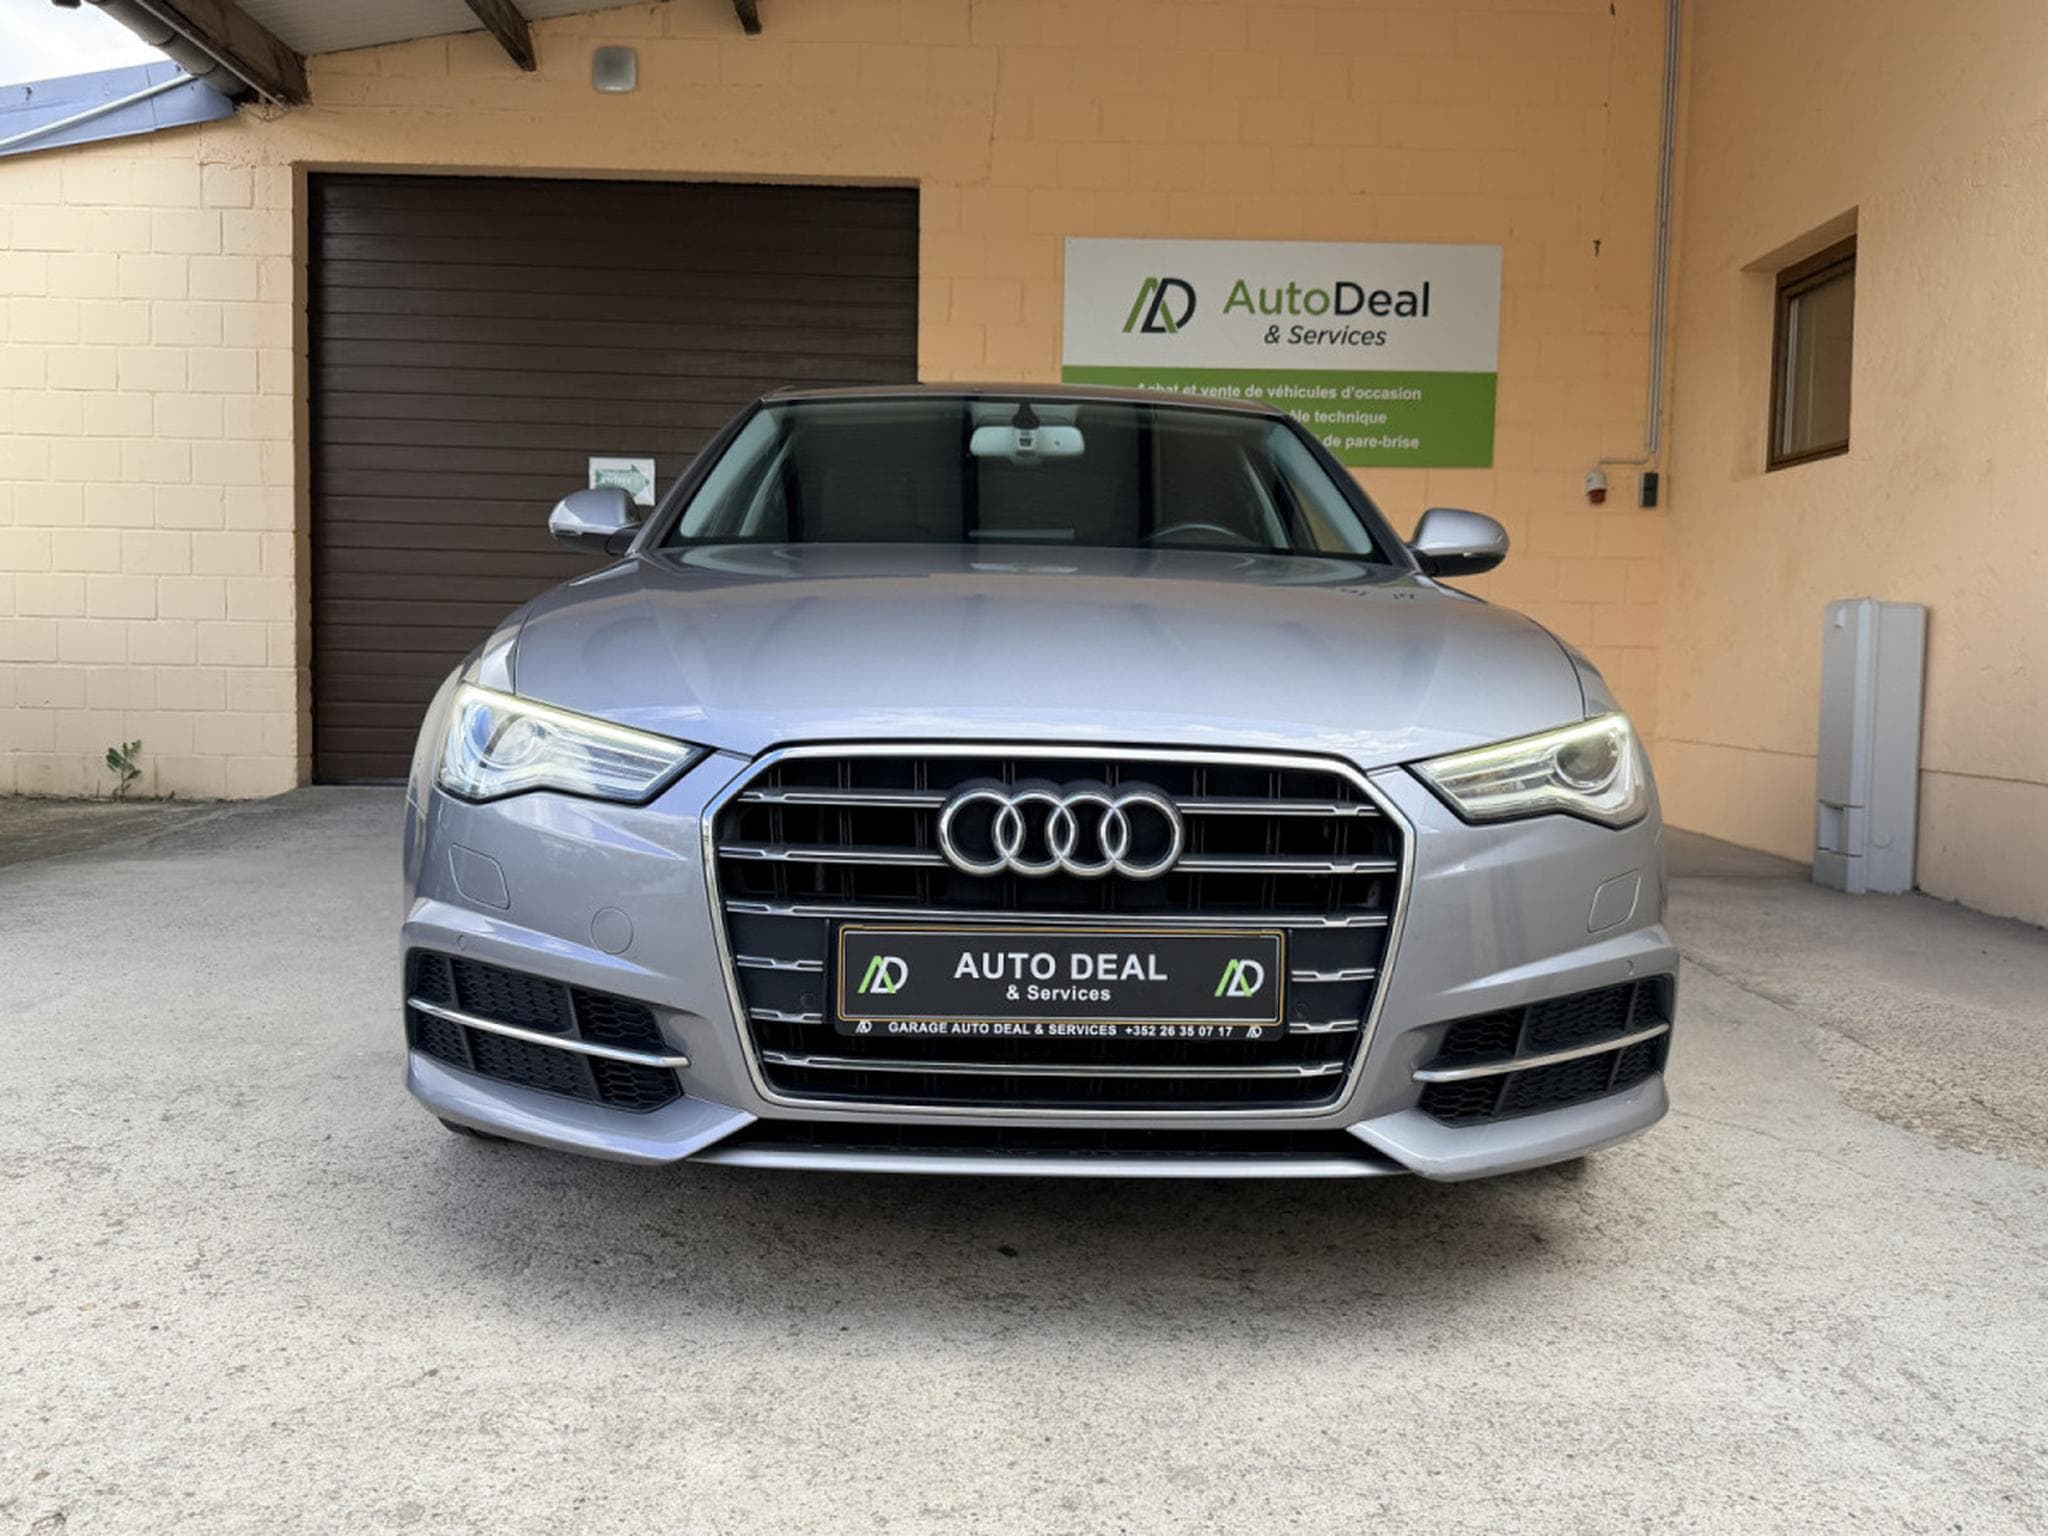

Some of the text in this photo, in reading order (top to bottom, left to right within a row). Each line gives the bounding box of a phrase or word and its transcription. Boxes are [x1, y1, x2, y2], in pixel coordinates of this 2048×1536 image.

[1223, 279, 1430, 317] AutoDeal
[1264, 324, 1387, 346] & Services
[1183, 384, 1197, 395] et
[1200, 384, 1241, 398] vente
[1245, 384, 1263, 397] de
[1267, 384, 1337, 399] véhicules
[1340, 386, 1421, 400] d'occasion
[1315, 410, 1387, 426] technique
[1323, 434, 1420, 450] de pare-brise
[953, 952, 1168, 981] AUTO DEAL
[1006, 984, 1111, 1001] & Services
[888, 1021, 948, 1034] GARAGE
[951, 1023, 990, 1034] AUTO
[993, 1023, 1031, 1035] DEAL
[1034, 1024, 1045, 1035] &
[1048, 1024, 1117, 1036] SERVICES
[1125, 1025, 1155, 1037] +352
[1198, 1026, 1213, 1037] 07
[1218, 1026, 1234, 1038] 17
